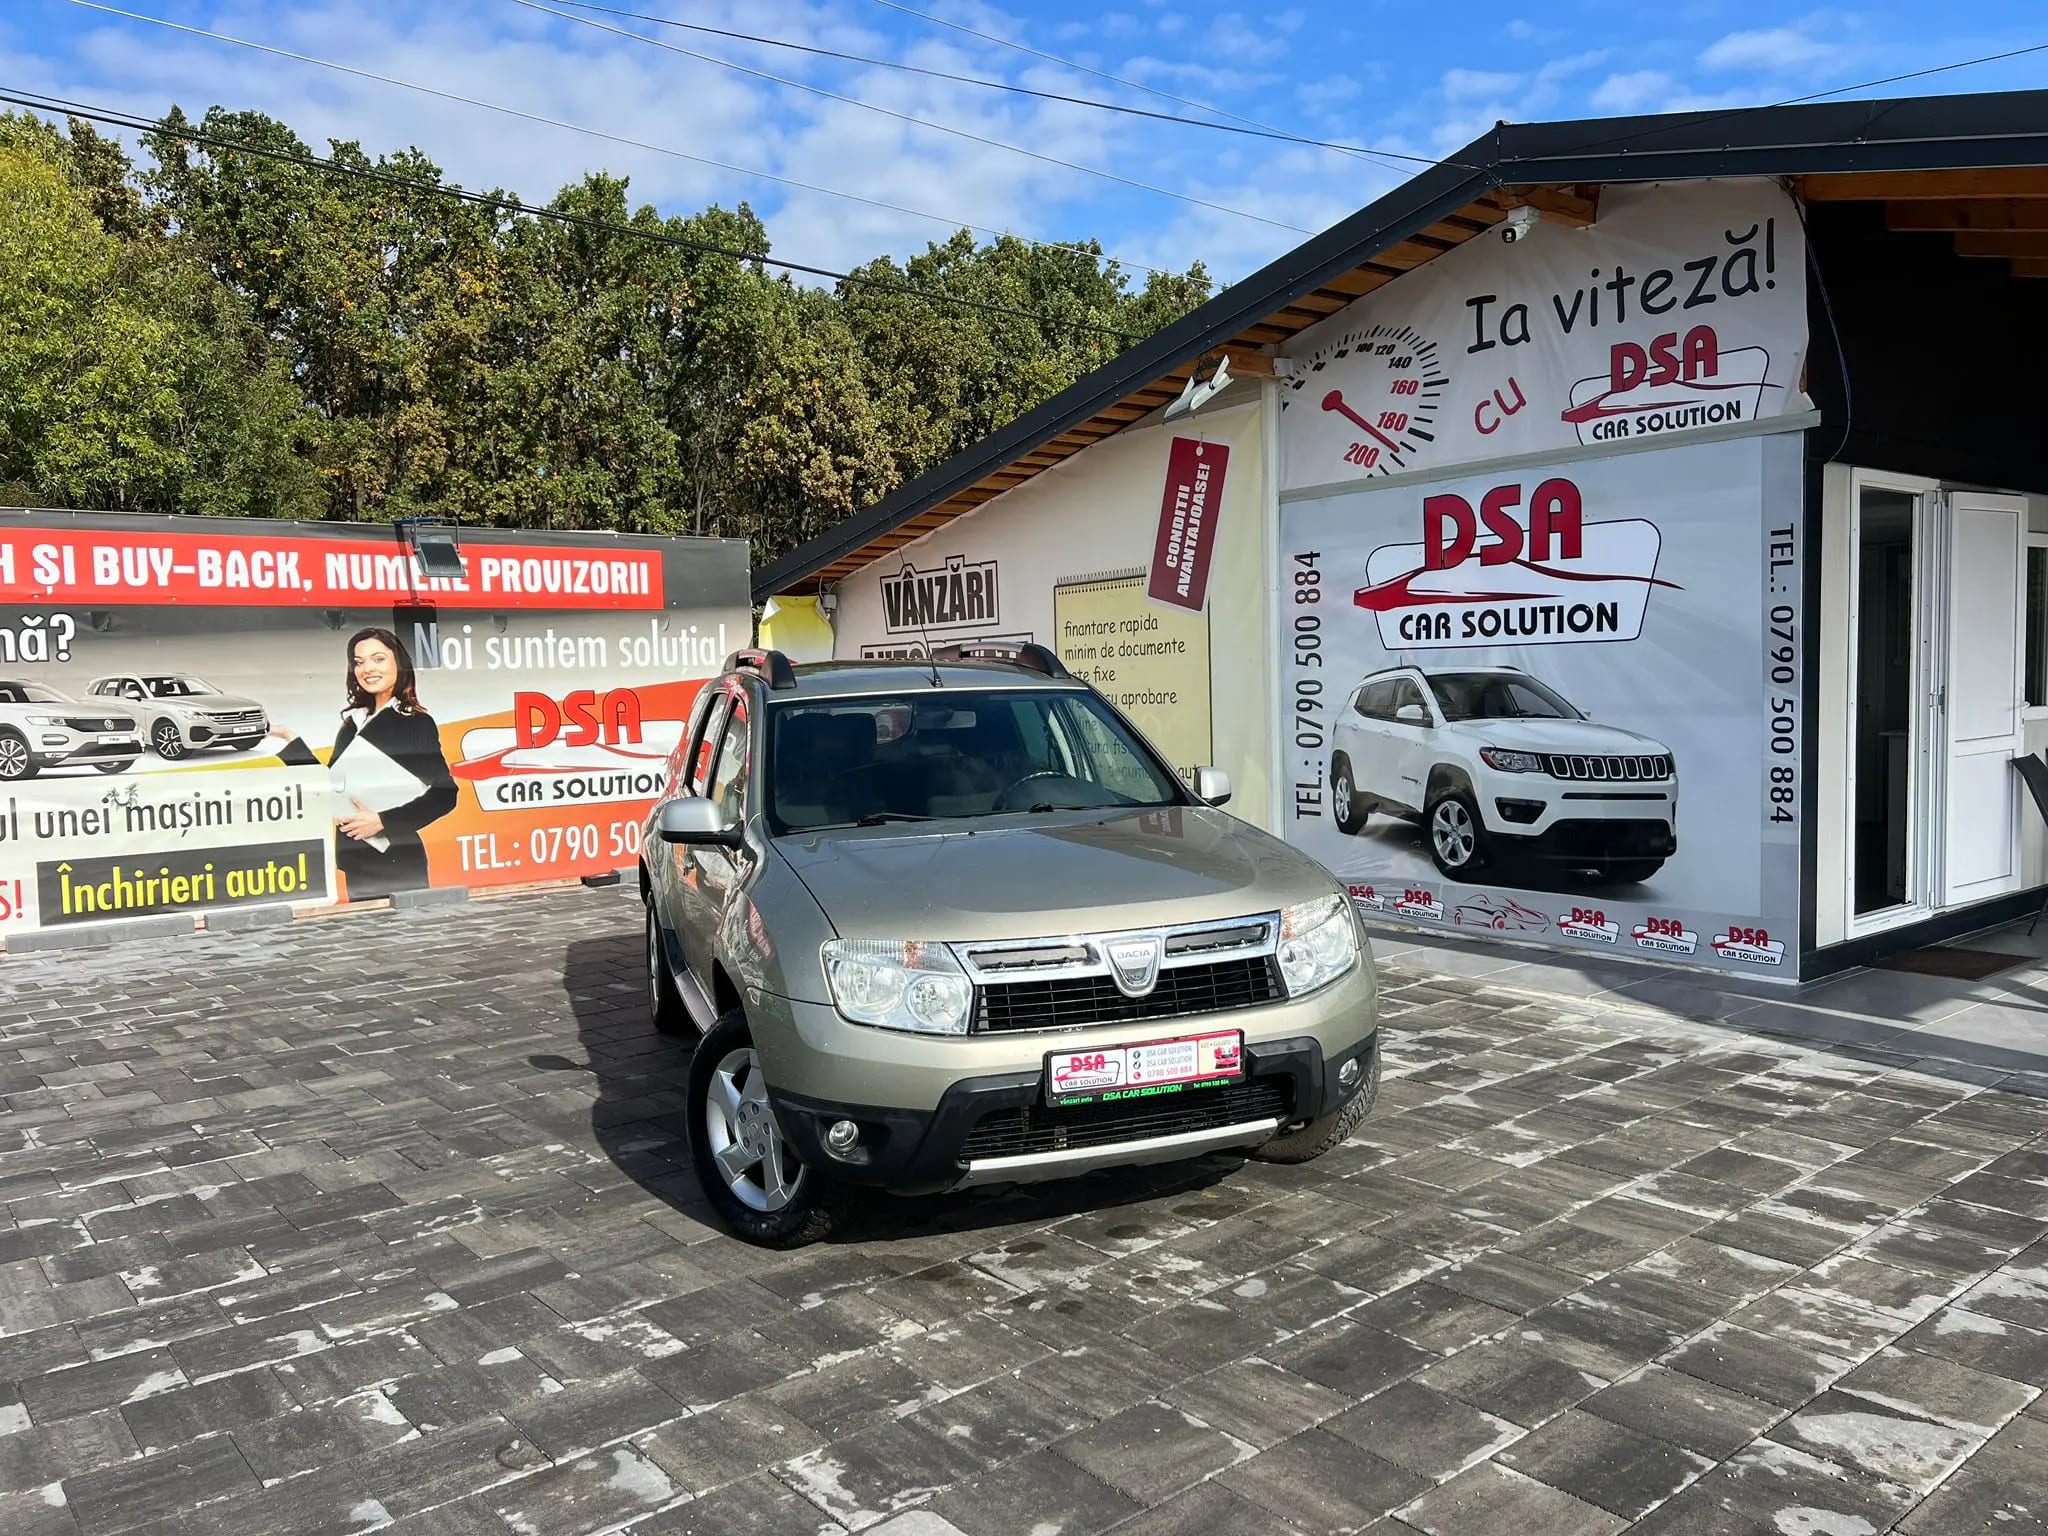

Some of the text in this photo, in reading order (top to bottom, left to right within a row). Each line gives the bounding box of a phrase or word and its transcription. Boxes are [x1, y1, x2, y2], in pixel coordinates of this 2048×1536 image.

[1466, 217, 1776, 354] Ia viteză!
[1374, 344, 1396, 355] 120
[1611, 324, 1718, 393] DSA
[1388, 356, 1413, 369] 140
[1390, 379, 1419, 395] 160
[1475, 376, 1527, 435] cu
[1377, 411, 1408, 432] 180
[1592, 400, 1741, 441] CAR SOLUTION
[1343, 442, 1380, 468] 200
[1166, 484, 1190, 568] CONDITII
[1177, 462, 1211, 598] AVANTAJOASE!
[1423, 478, 1583, 570] DSA
[481, 557, 648, 594] PROVIZORII
[1294, 550, 1321, 605] 884
[885, 563, 995, 627] VÂNZĂRI
[1064, 613, 1158, 638] finantare rapida
[1400, 602, 1618, 640] CAR SOLUTION
[413, 619, 726, 675] Noi suntem soluția!
[1065, 638, 1185, 660] minim de documente
[1294, 615, 1322, 668] 500
[1770, 604, 1794, 684] 0790
[1093, 665, 1116, 683] fixe
[1121, 688, 1177, 709] aprobare
[514, 688, 642, 749] DSA
[1295, 679, 1324, 749] 0790
[1770, 697, 1795, 754] 500
[496, 778, 543, 803] CAR
[1769, 766, 1794, 823] 884
[34, 798, 110, 839] unei
[126, 790, 232, 838] mașini
[246, 784, 304, 822] noi!
[456, 822, 643, 872] TEL.: 0790 50
[56, 862, 214, 915] Închirieri
[226, 853, 308, 898] auto!
[1404, 889, 1432, 905] DSA
[1412, 910, 1438, 918] SOLUTION
[1571, 907, 1605, 927] DSA
[1565, 928, 1612, 942] CAR SOLUTION
[1647, 917, 1682, 937] DSA
[1728, 926, 1768, 947] DSA
[1117, 949, 1150, 959] DACIA
[1641, 939, 1690, 952] CAR SOLUTION
[1722, 950, 1776, 963] CAR SOLUTION
[1070, 1053, 1105, 1072] DSA
[1158, 1047, 1167, 1055] CAR
[1168, 1045, 1192, 1055] SOLUTION
[1080, 1077, 1112, 1086] SOLUTION
[1103, 1084, 1182, 1101] DSA CAR SOLUTION
